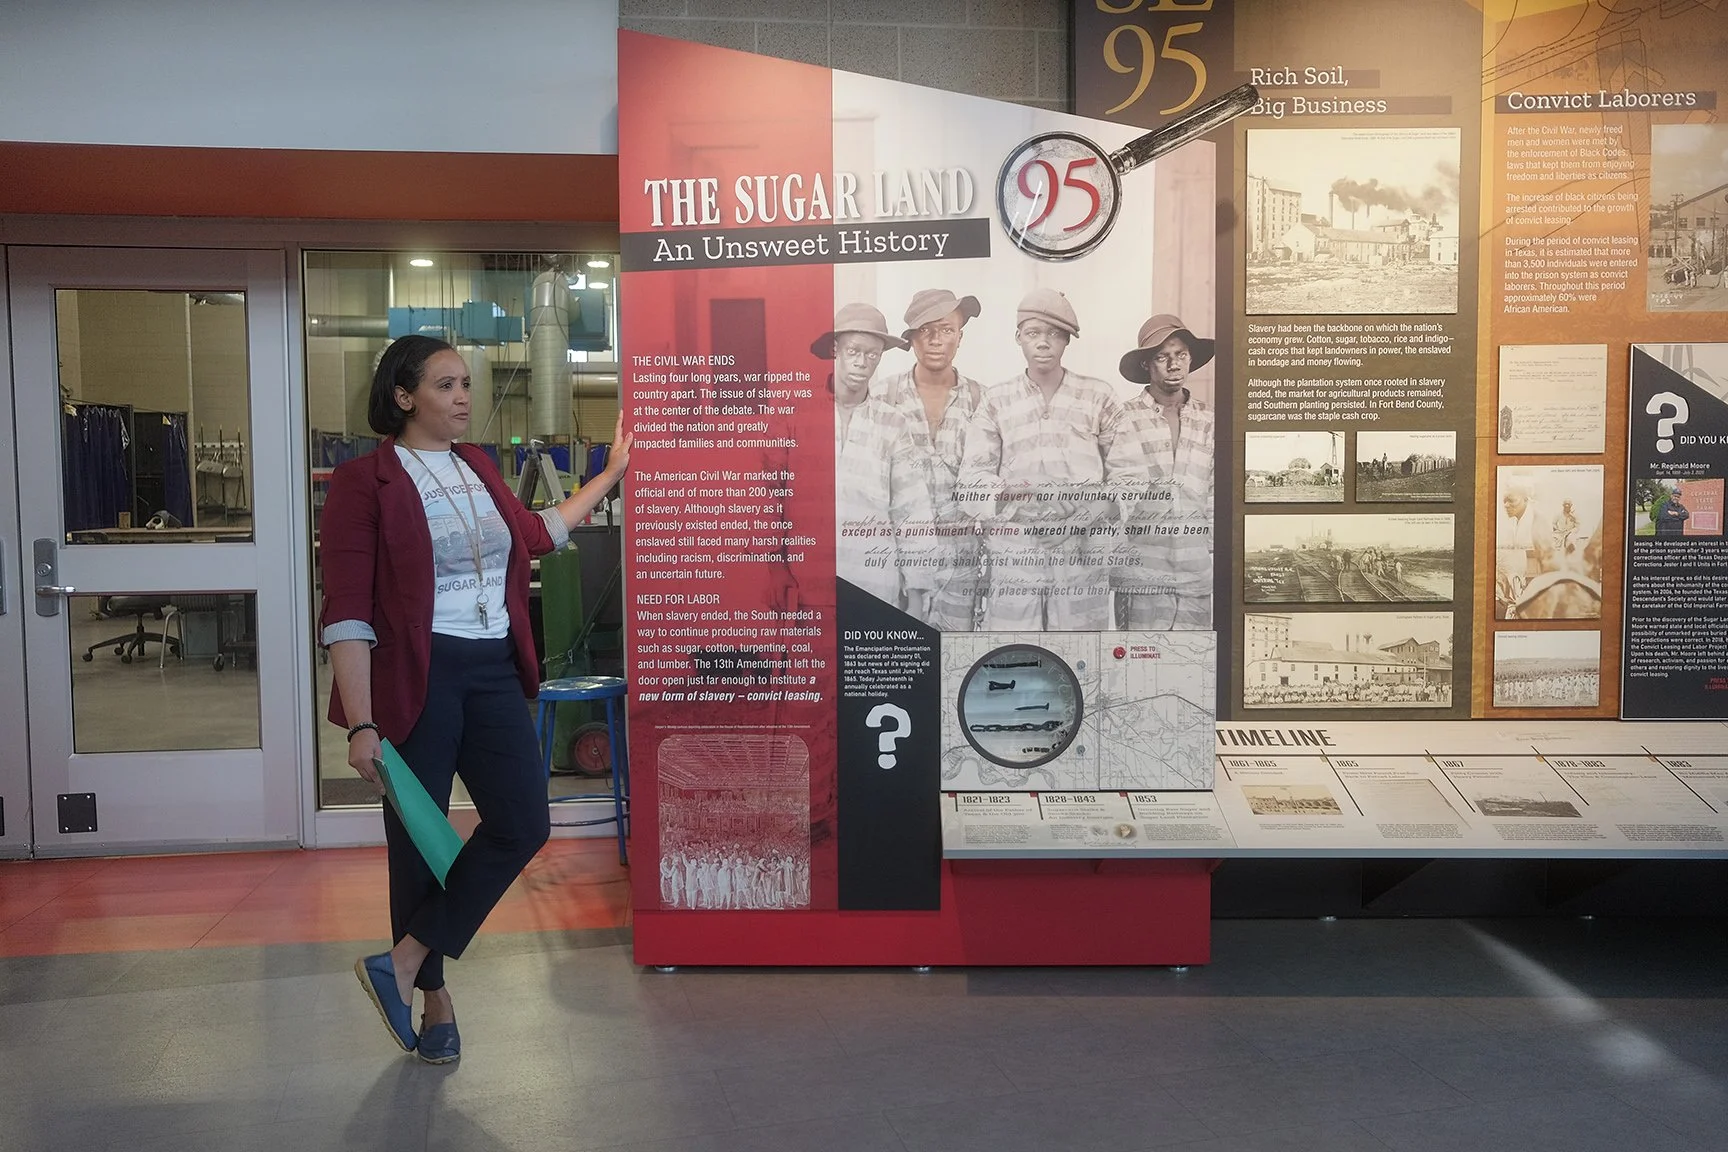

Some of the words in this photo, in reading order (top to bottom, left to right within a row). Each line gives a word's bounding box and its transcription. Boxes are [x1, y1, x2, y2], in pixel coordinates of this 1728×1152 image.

[1103, 22, 1207, 116] 95
[1250, 66, 1298, 86] Rich
[1304, 66, 1348, 88] Soil,
[1508, 92, 1592, 110] Convict
[1598, 90, 1697, 108] Laborers
[1250, 97, 1286, 119] Big
[1292, 96, 1387, 114] Business
[1507, 126, 1525, 135] After
[1528, 126, 1540, 134] the
[1541, 126, 1557, 134] Civil
[1580, 125, 1601, 136] newly
[1604, 125, 1623, 134] freed
[644, 177, 721, 228] THE
[734, 172, 860, 226] SUGAR
[872, 166, 975, 218] LAND
[1016, 157, 1102, 233] 95
[652, 238, 694, 263] An
[703, 233, 830, 260] Unsweet
[838, 228, 950, 258] History
[1504, 292, 1557, 303] approximately
[1558, 293, 1576, 302] 60%
[1504, 304, 1530, 313] African
[1532, 304, 1570, 313] American.
[1248, 324, 1276, 334] Slavery
[1314, 324, 1325, 332] the
[1327, 324, 1362, 332] backbone
[1376, 323, 1399, 332] which
[1414, 323, 1442, 332] nation's
[633, 356, 651, 366] THE
[654, 356, 680, 366] CIVIL
[682, 356, 705, 365] WAR
[708, 355, 734, 365] ENDS
[634, 373, 666, 384] Lasting
[669, 372, 688, 382] four
[691, 372, 711, 384] long
[714, 374, 741, 384] years,
[764, 371, 792, 383] ripped
[796, 372, 810, 381] the
[634, 390, 668, 401] country
[671, 389, 697, 400] apart.
[700, 388, 717, 398] The
[720, 388, 744, 398] issue
[746, 388, 756, 398] of
[758, 388, 791, 400] slavery
[1680, 436, 1696, 444] DID
[1698, 436, 1717, 444] YOU
[635, 471, 651, 481] The
[654, 471, 697, 481] American
[700, 471, 719, 481] Civil
[722, 471, 741, 480] War
[744, 470, 777, 480] marked
[780, 470, 794, 480] the
[468, 484, 486, 492] FO
[635, 488, 665, 497] official
[668, 488, 684, 497] end
[688, 487, 696, 497] of
[700, 489, 723, 497] more
[726, 487, 746, 497] than
[749, 487, 766, 497] 200
[769, 489, 793, 498] years
[952, 492, 991, 501] Neither
[994, 492, 1032, 502] slavery
[1036, 492, 1054, 501] nor
[1058, 491, 1118, 502] involuntary
[1121, 490, 1175, 502] servitude,
[842, 526, 877, 538] except
[905, 526, 968, 538] punishment
[971, 526, 987, 536] for
[989, 526, 1020, 536] crime
[1023, 525, 1067, 535] whereof
[1070, 525, 1086, 535] the
[1089, 525, 1120, 537] party,
[1124, 525, 1150, 535] shall
[1154, 525, 1179, 535] have
[1183, 525, 1209, 535] been
[865, 557, 887, 568] duly
[894, 556, 948, 568] convicted,
[952, 556, 980, 566] shall
[983, 556, 1008, 566] exist
[1012, 556, 1044, 566] within
[1048, 556, 1065, 566] the
[1069, 556, 1103, 566] United
[1107, 556, 1144, 567] States,
[438, 579, 477, 594] SUGAR
[977, 588, 995, 598] any
[999, 586, 1027, 596] place
[1032, 586, 1071, 597] subject
[1073, 586, 1084, 595] to
[1087, 586, 1113, 595] their
[637, 594, 662, 604] NEED
[666, 594, 684, 604] FOR
[688, 594, 720, 604] LABOR
[637, 611, 663, 620] When
[666, 611, 698, 622] slavery
[701, 610, 731, 621] ended,
[734, 610, 748, 620] the
[751, 610, 778, 620] South
[781, 610, 813, 620] needed
[845, 631, 861, 640] DID
[864, 631, 883, 640] YOU
[887, 631, 924, 640] KNOW...
[662, 691, 684, 701] form
[687, 691, 698, 701] of
[699, 691, 735, 703] slavery
[747, 690, 782, 700] convict
[784, 690, 822, 702] leasing.
[1216, 729, 1336, 746] TIMELINE
